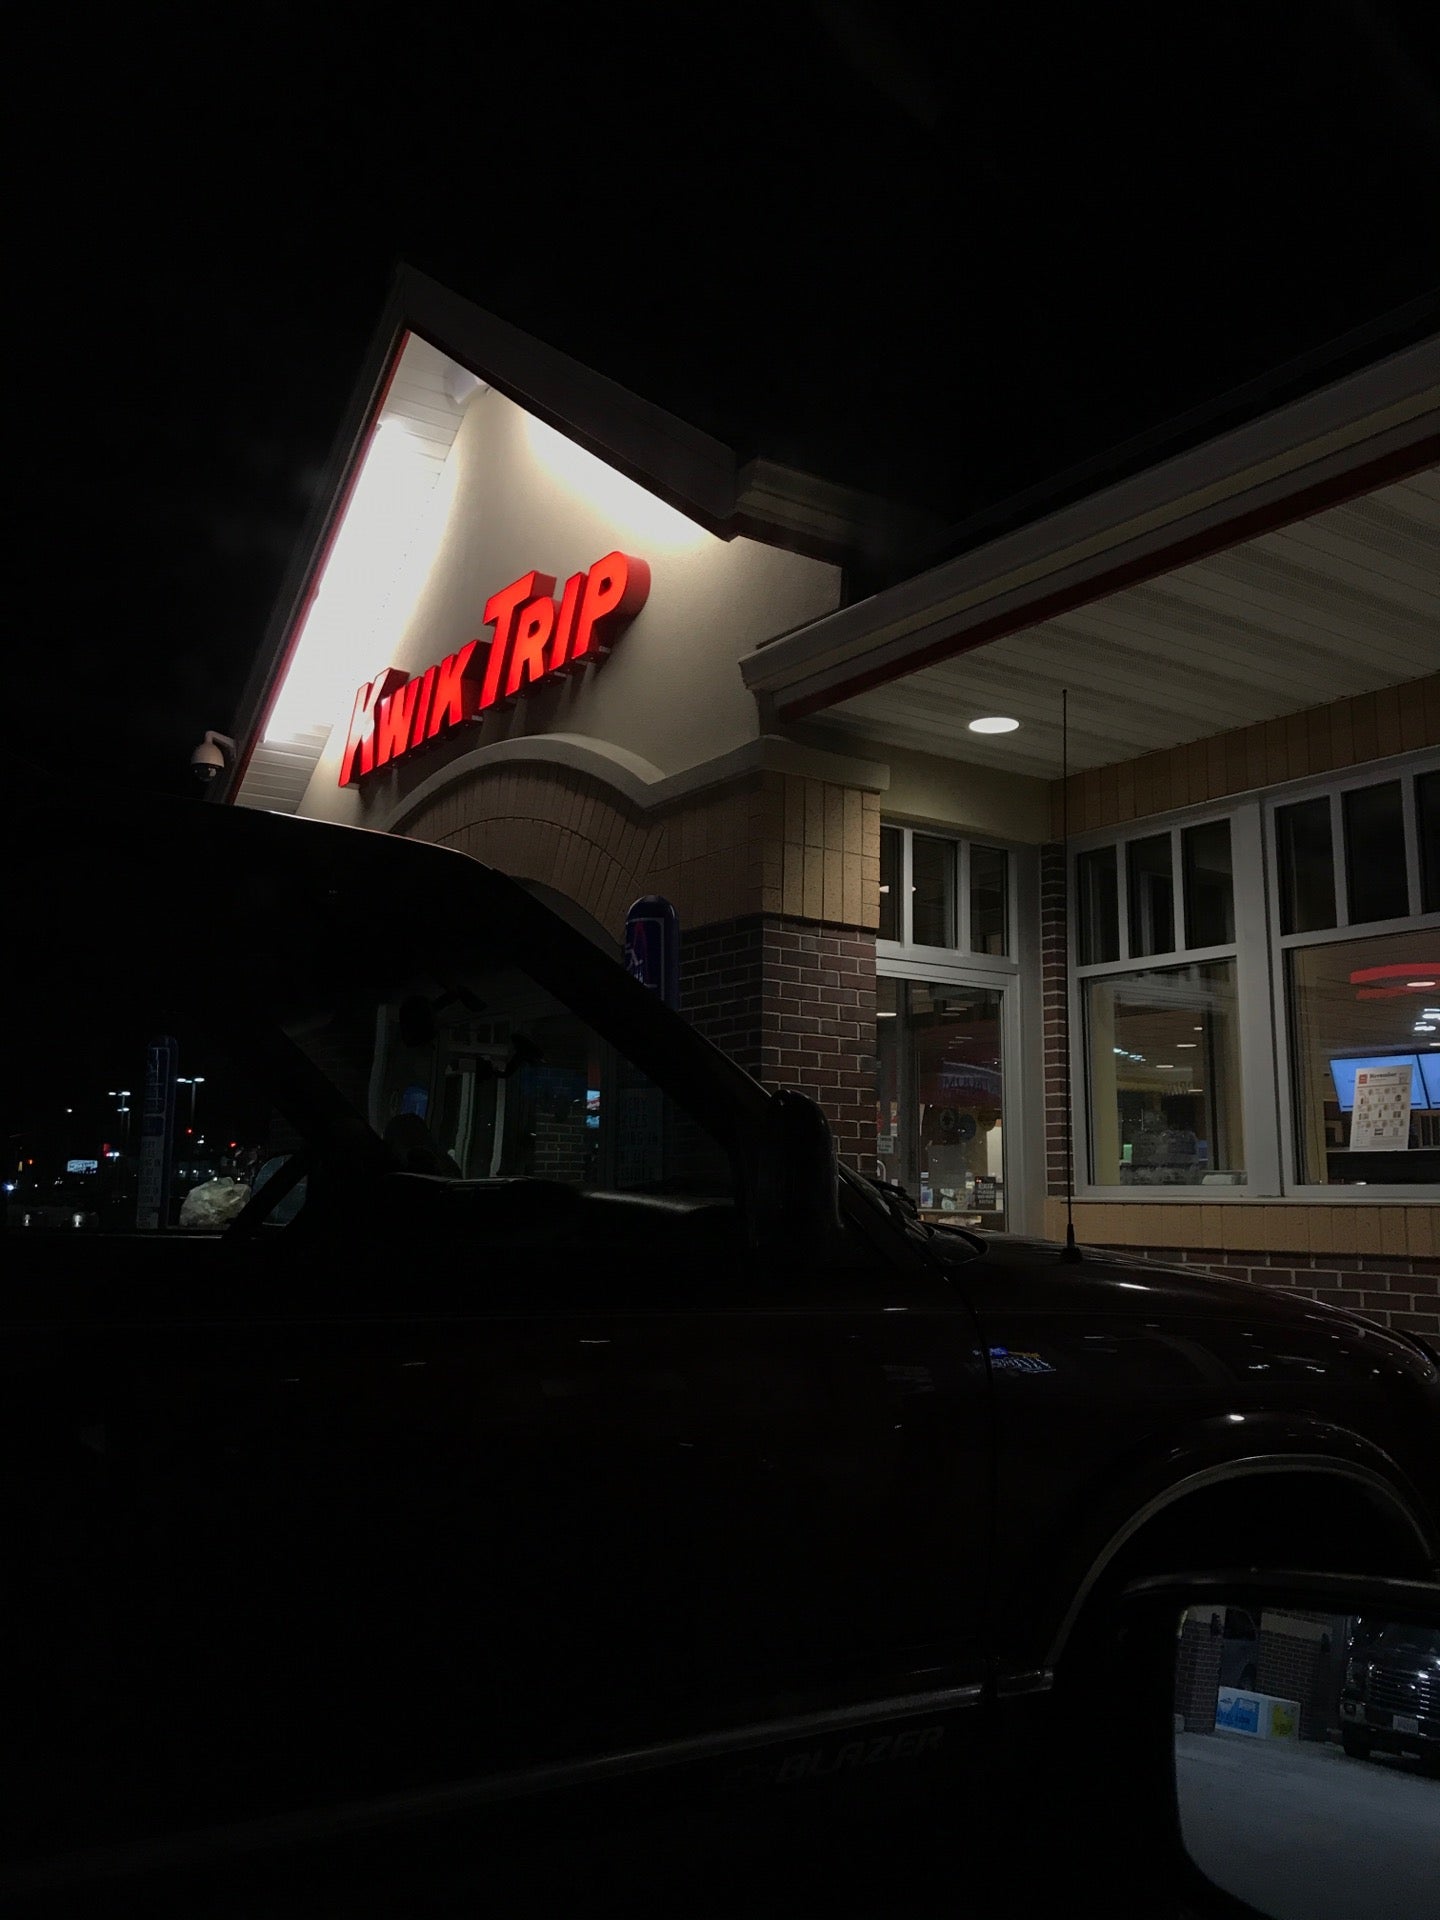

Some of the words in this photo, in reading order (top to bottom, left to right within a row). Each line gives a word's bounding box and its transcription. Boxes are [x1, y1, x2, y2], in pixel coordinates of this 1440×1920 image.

[338, 639, 487, 788] KWIK
[479, 550, 646, 710] TRIP
[775, 1725, 946, 1784] BLAZER
